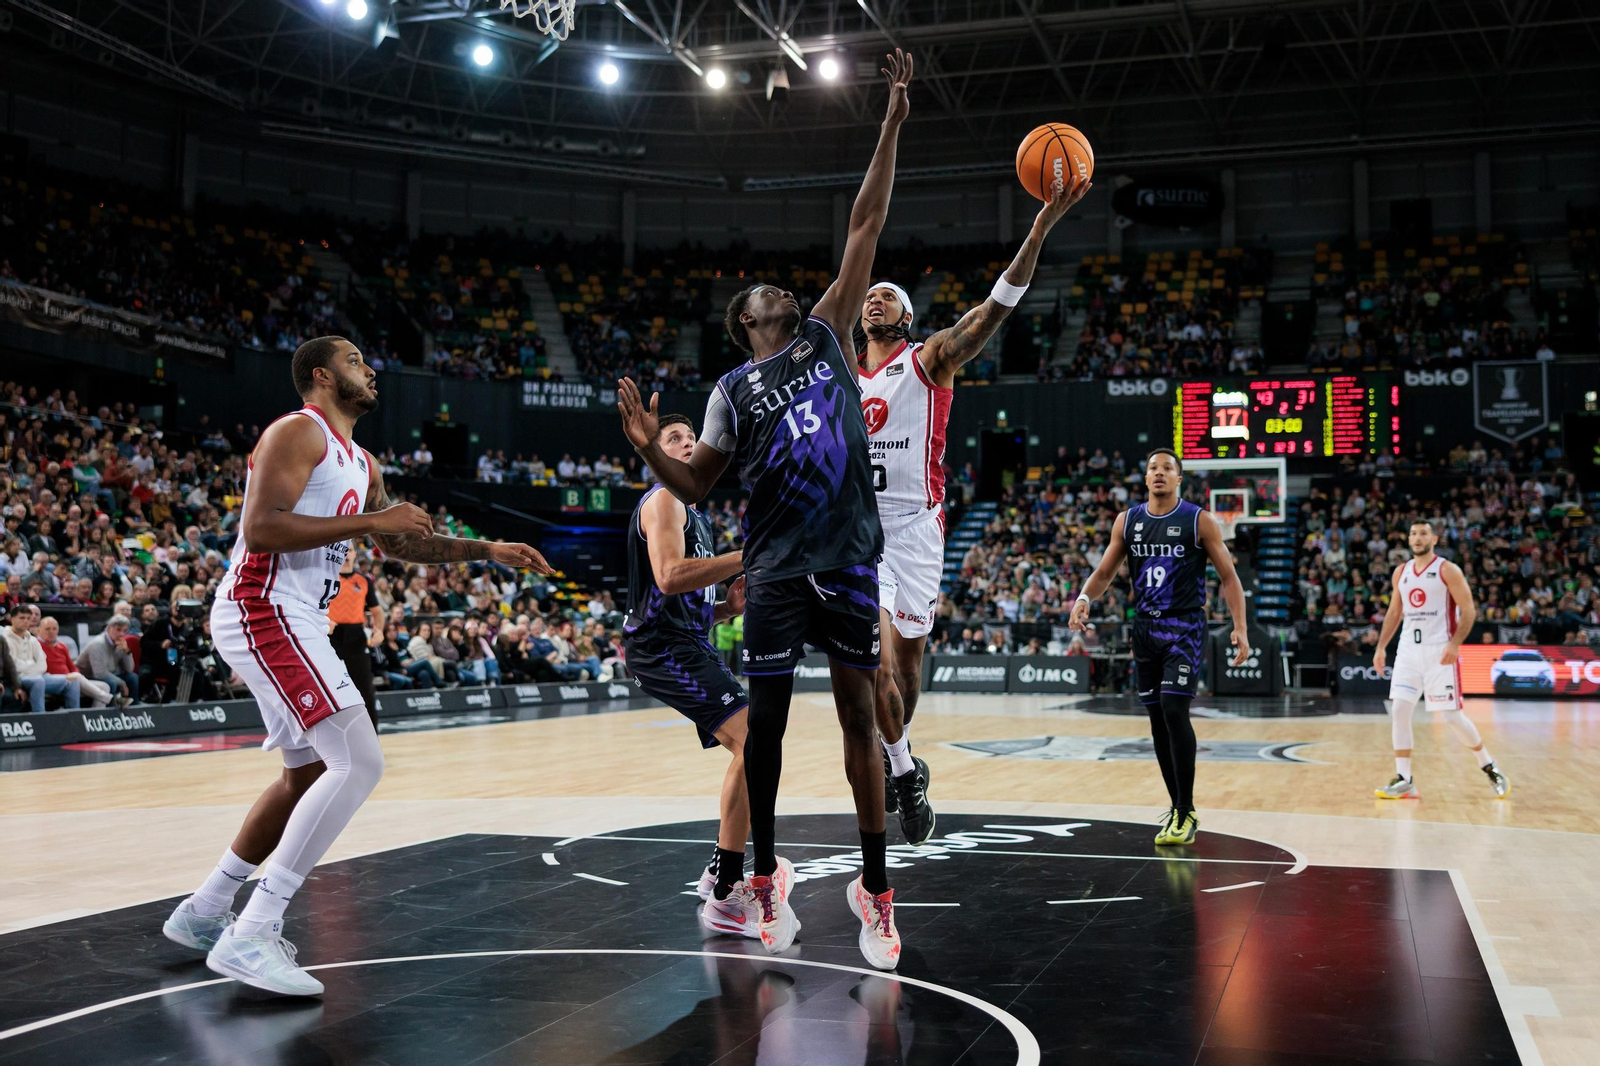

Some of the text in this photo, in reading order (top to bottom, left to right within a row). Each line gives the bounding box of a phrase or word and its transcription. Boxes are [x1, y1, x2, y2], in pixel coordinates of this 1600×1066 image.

[82, 315, 110, 330] BASKET
[112, 322, 141, 338] OFICIAL
[1404, 369, 1450, 386] bbk
[523, 381, 540, 393] UN
[750, 361, 834, 422] surne
[1107, 379, 1150, 396] bbk
[523, 394, 588, 408] UNA CAUSA
[1256, 389, 1315, 406] 43 31
[1279, 401, 1289, 415] 2
[783, 399, 822, 441] 13
[1215, 408, 1242, 427] 17
[1265, 418, 1303, 433] 03:00
[567, 490, 579, 507] B
[1130, 543, 1185, 557] surne
[1146, 566, 1166, 588] 19
[1413, 628, 1422, 644] 0
[764, 651, 791, 660] CORREO
[1036, 668, 1078, 685] IMQ
[82, 711, 155, 733] kutxabank
[189, 708, 215, 721] bbk
[1, 721, 34, 737] RAC
